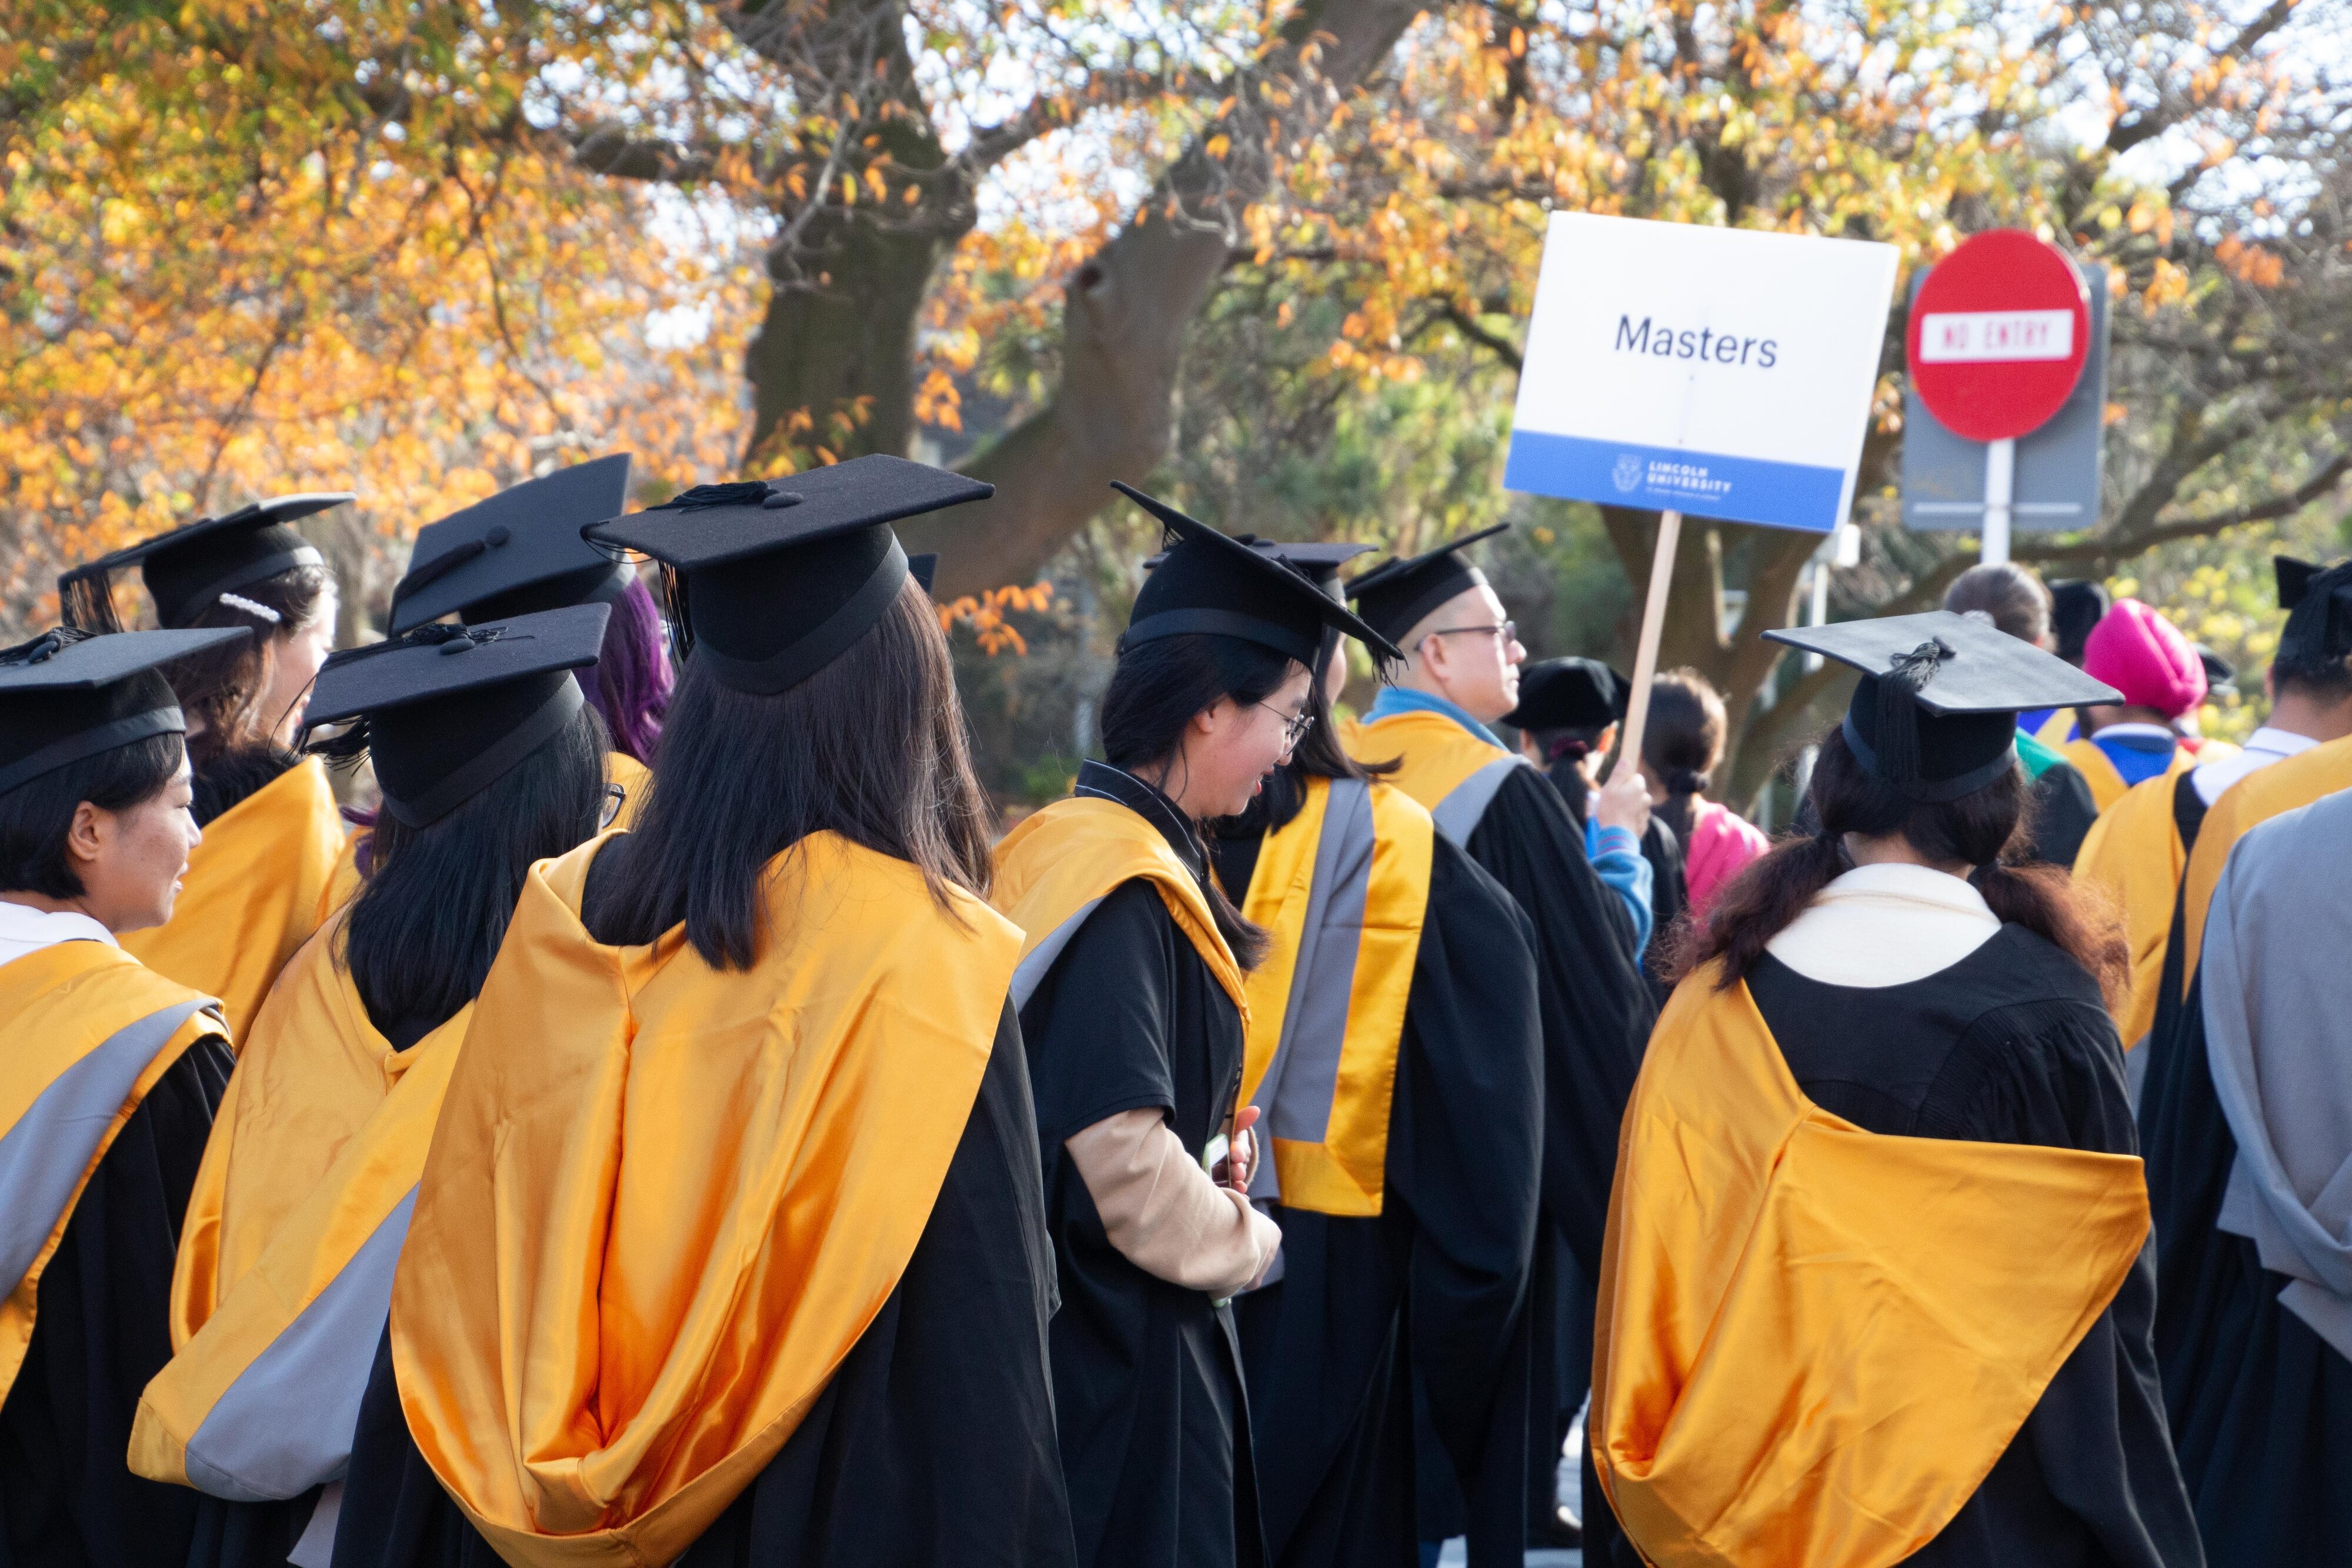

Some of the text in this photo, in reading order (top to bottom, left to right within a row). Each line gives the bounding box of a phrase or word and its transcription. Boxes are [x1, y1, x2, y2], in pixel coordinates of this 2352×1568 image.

[1614, 315, 1778, 369] Masters
[1943, 319, 2051, 350] NO ENTRY
[1649, 461, 1708, 477] LINCOLN
[1647, 472, 1732, 492] UNIVERSITY
